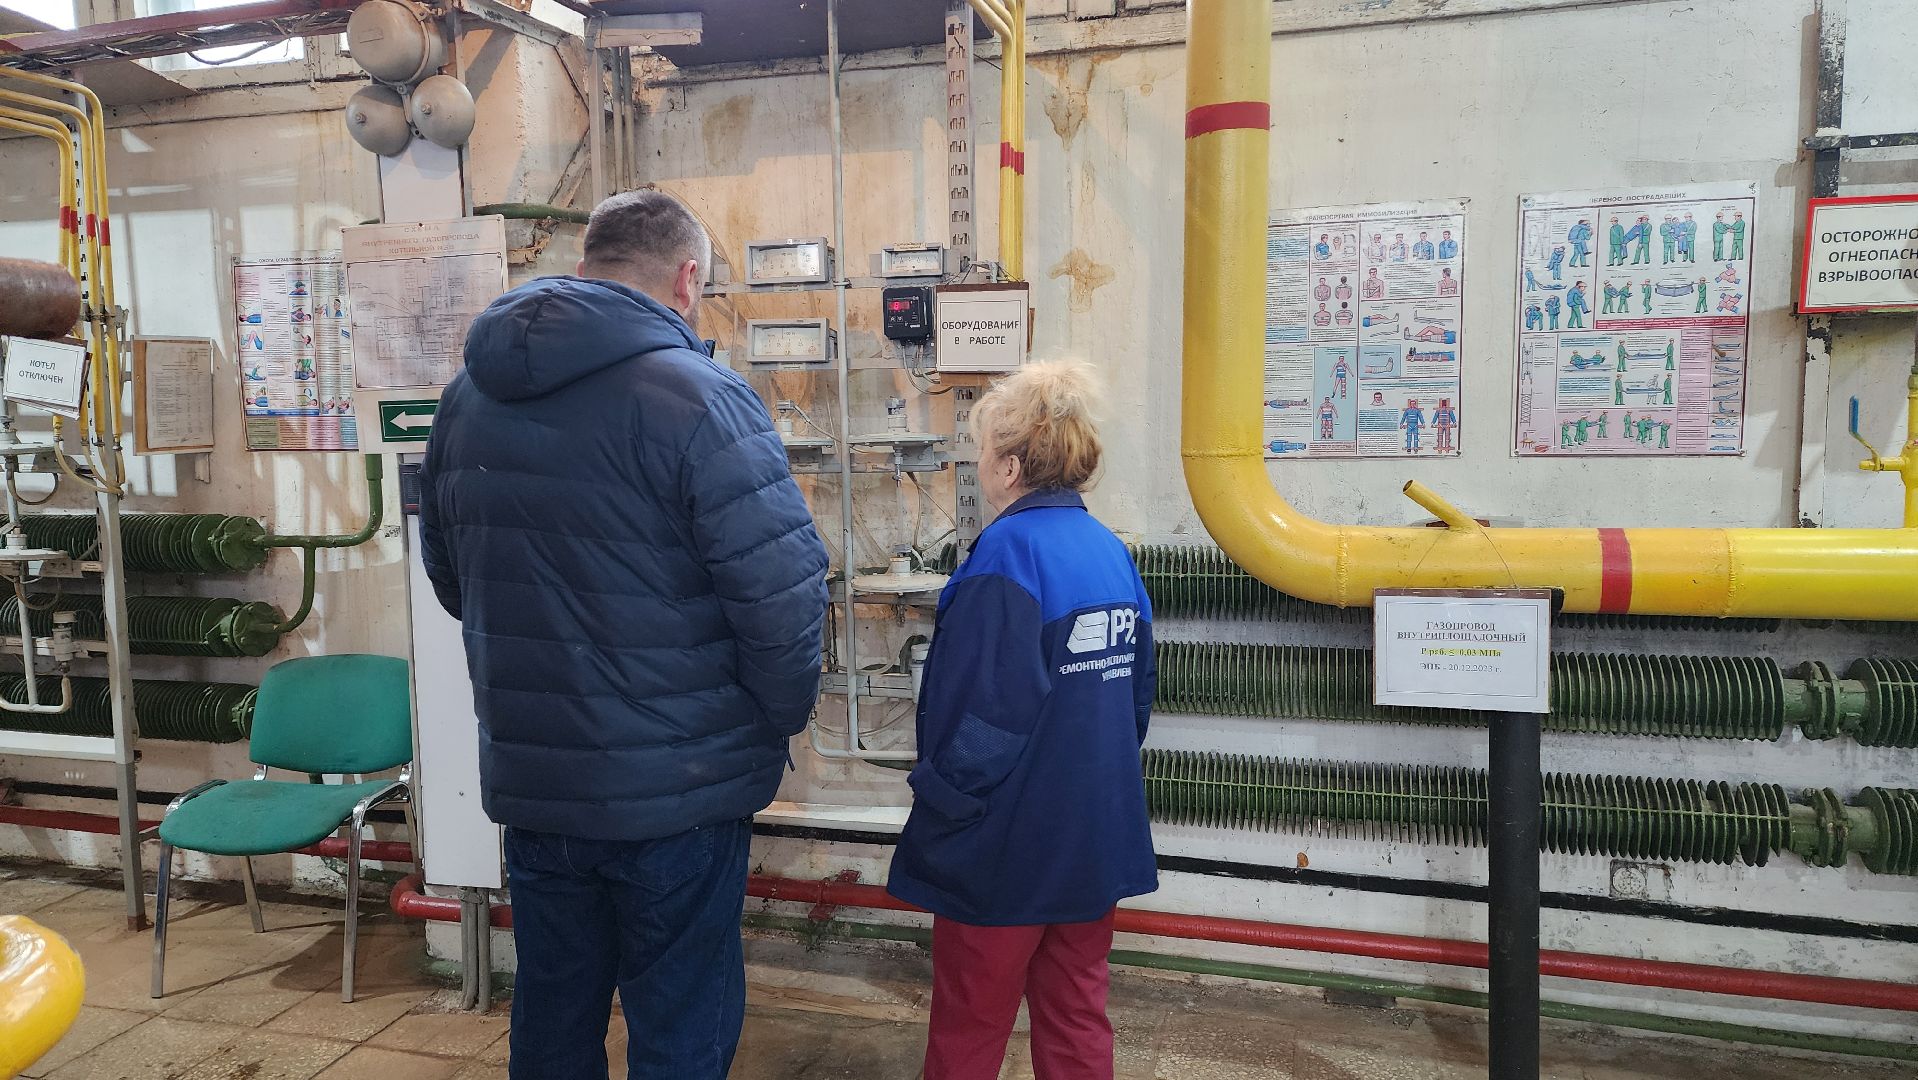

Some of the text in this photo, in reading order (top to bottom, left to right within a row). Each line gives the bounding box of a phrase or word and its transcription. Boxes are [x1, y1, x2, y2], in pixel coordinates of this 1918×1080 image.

[1626, 192, 1687, 201] ПОСТРАДАВШИХ
[941, 320, 1019, 331] ОБОРУДОВАНИЕ
[954, 336, 1006, 345] В РАБОТЕ
[29, 359, 56, 371] КОТЕЛ
[18, 370, 64, 384] ОТКЛЮЧЕН
[1426, 621, 1496, 631] ГАЗОПРОВОД
[1397, 631, 1527, 643] ВНУТРИПЛОЩАДОЧНЫЙ
[1479, 649, 1501, 657] МПа
